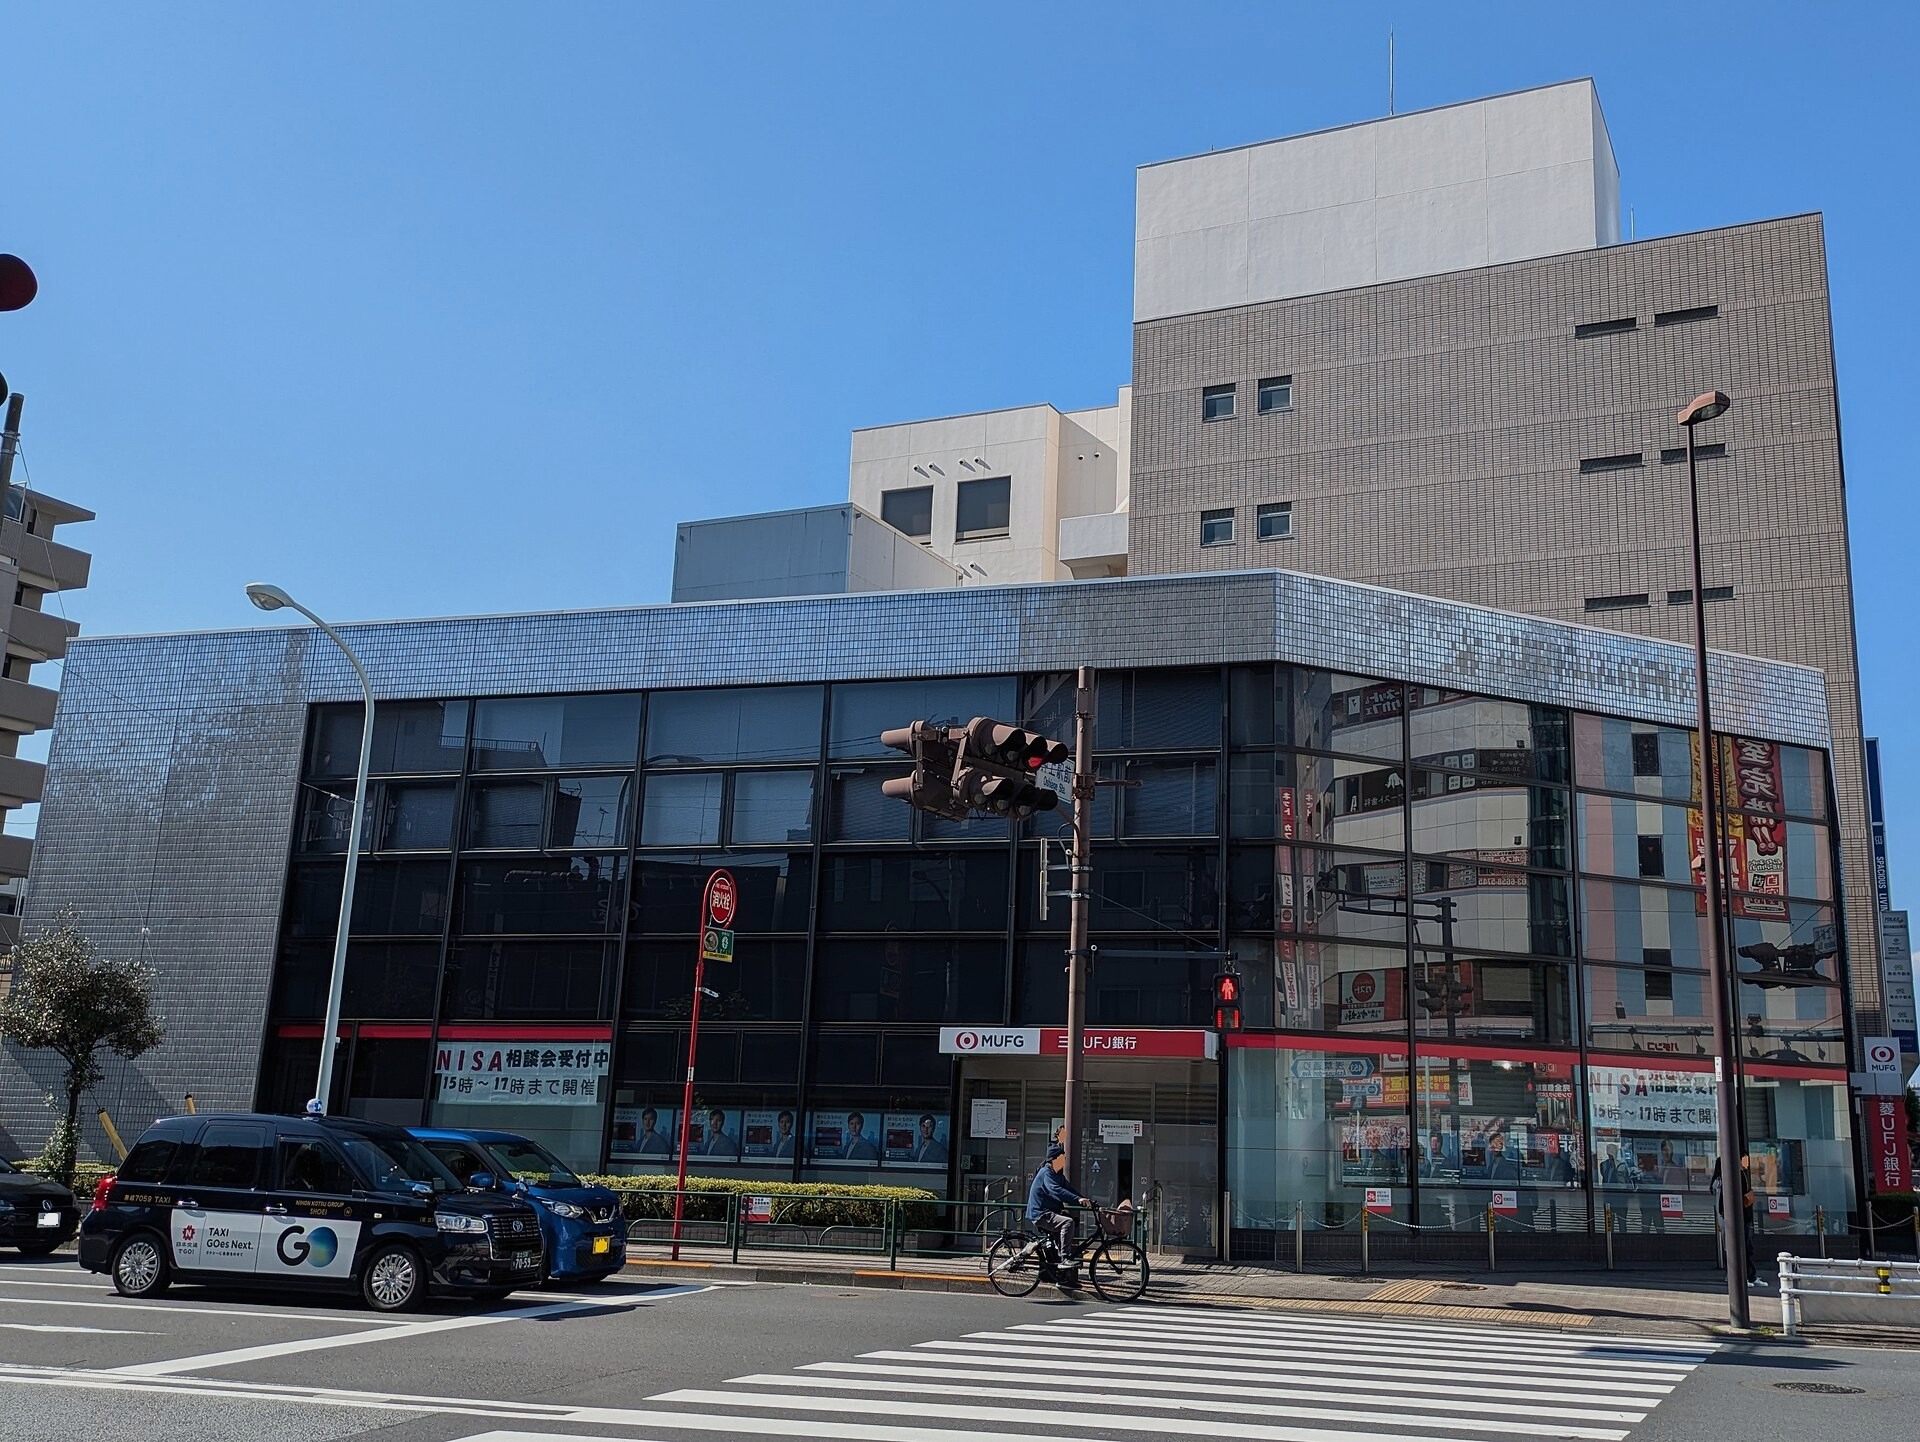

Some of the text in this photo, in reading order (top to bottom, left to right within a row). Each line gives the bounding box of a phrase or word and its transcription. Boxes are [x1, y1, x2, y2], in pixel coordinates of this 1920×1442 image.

[981, 1035, 1024, 1047] MUFG
[1057, 1036, 1137, 1050] 三UFJ銀行
[1872, 1064, 1896, 1072] MUFG
[154, 1196, 172, 1204] TAXI
[209, 1228, 230, 1237] TAXI
[206, 1239, 254, 1250] GOes Next.
